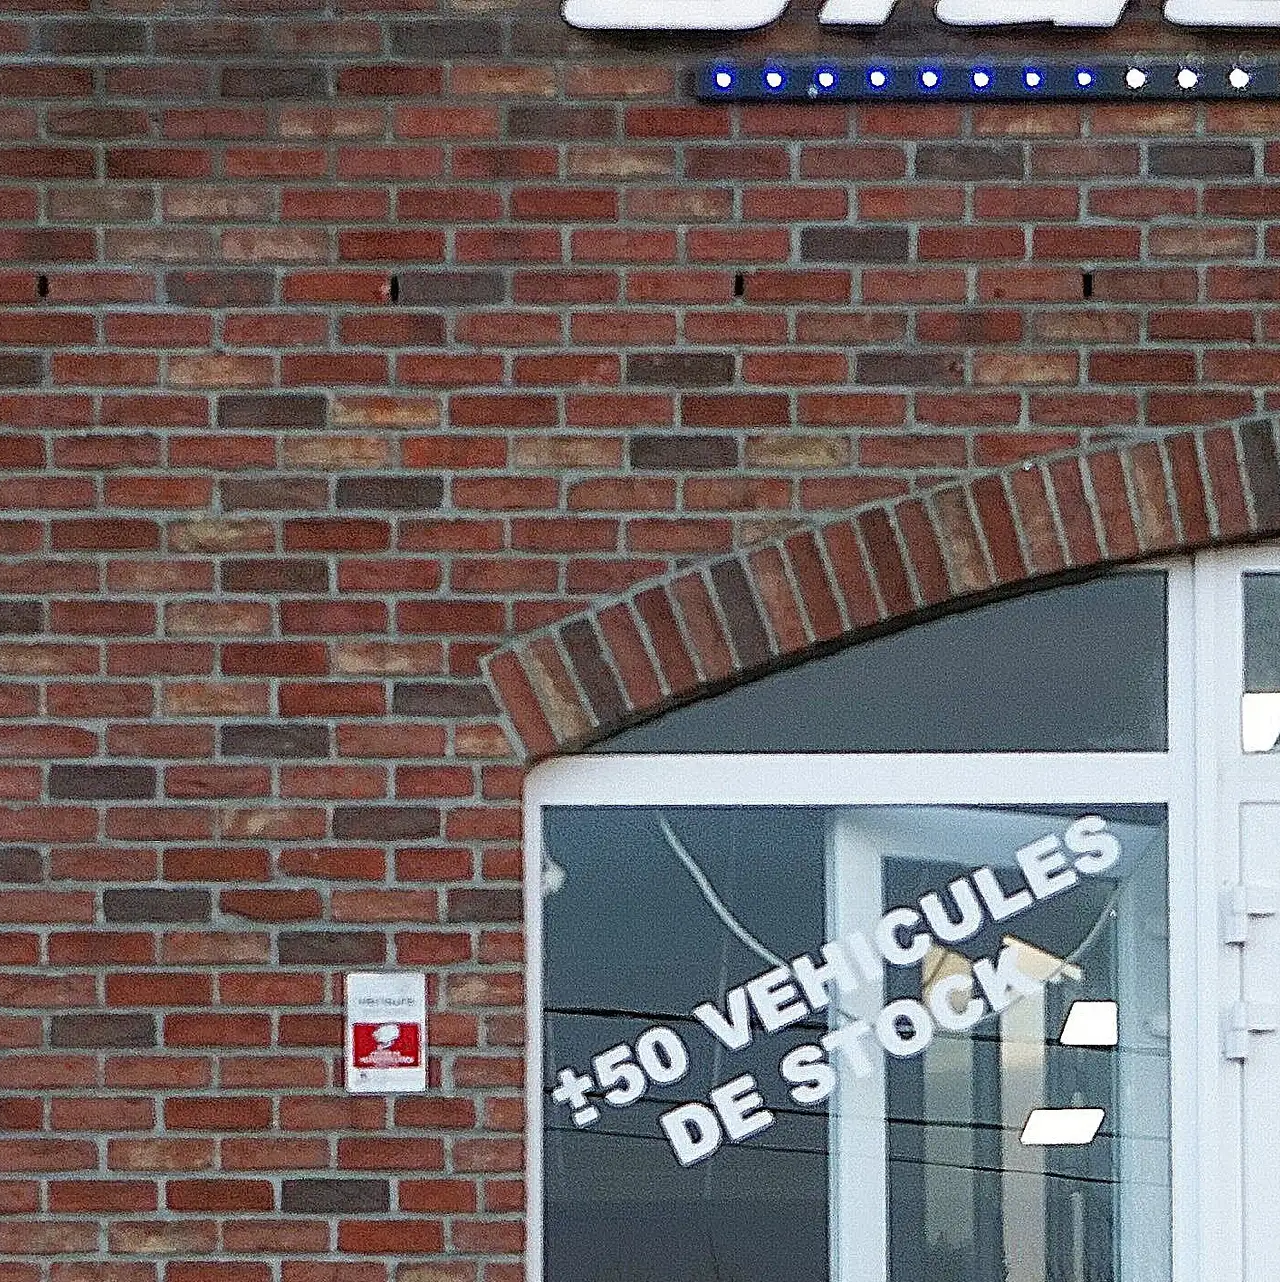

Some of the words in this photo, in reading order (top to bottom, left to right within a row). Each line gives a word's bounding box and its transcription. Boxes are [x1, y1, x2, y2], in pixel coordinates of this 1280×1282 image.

[693, 814, 1123, 1050] VEHICULES
[661, 1073, 774, 1165] DE
[780, 944, 1044, 1105] STOCK
